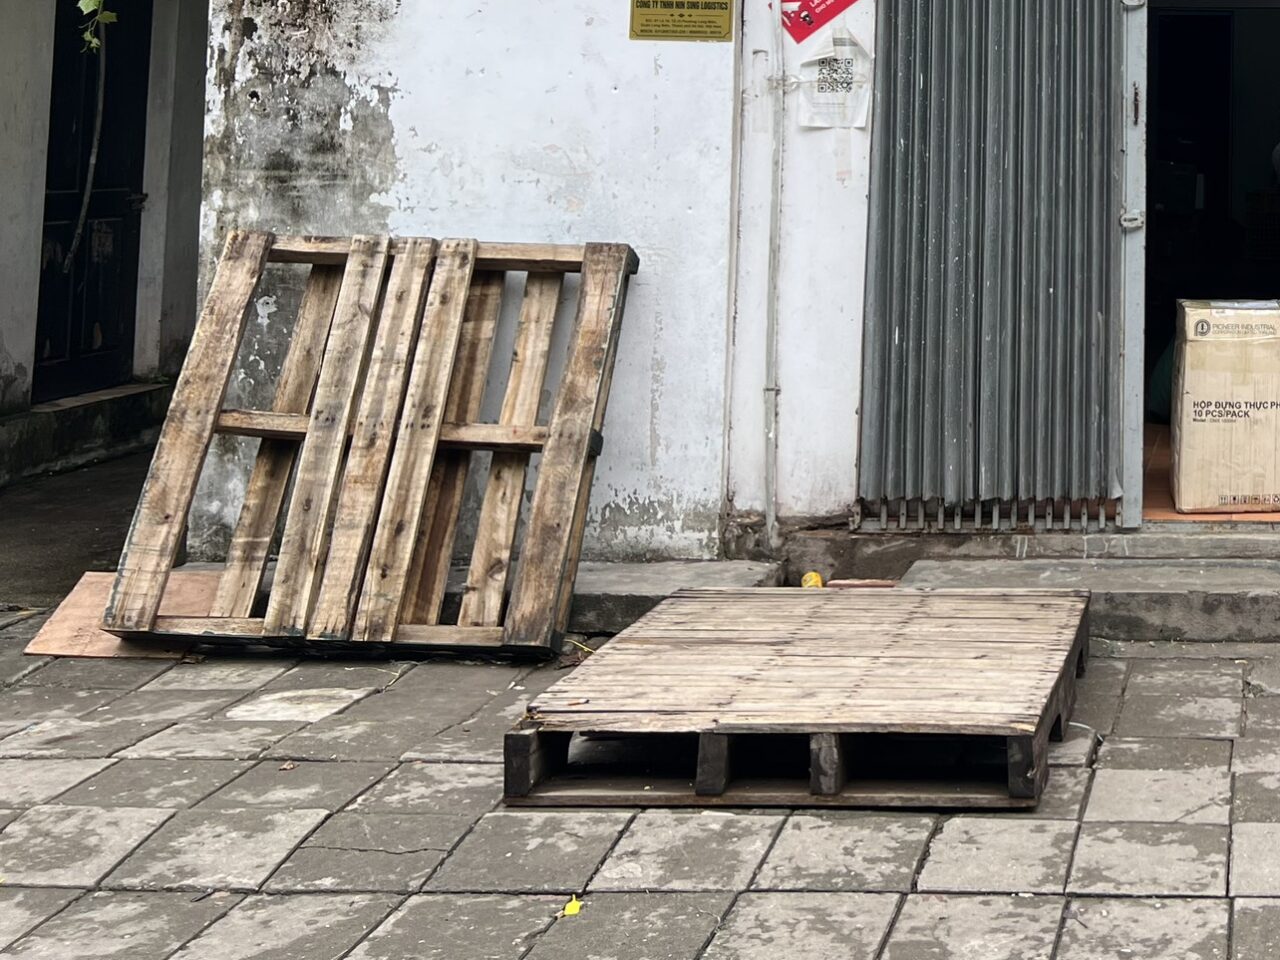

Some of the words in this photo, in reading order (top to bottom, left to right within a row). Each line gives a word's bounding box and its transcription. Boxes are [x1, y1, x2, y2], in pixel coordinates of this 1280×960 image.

[652, 0, 659, 9] TY
[700, 1, 729, 10] LOGISTICS
[1193, 400, 1212, 410] HỘP
[1214, 400, 1242, 411] ĐỰNG
[1244, 401, 1269, 411] THỰC
[1193, 410, 1203, 418] 10
[1205, 410, 1250, 418] PCS/PACK
